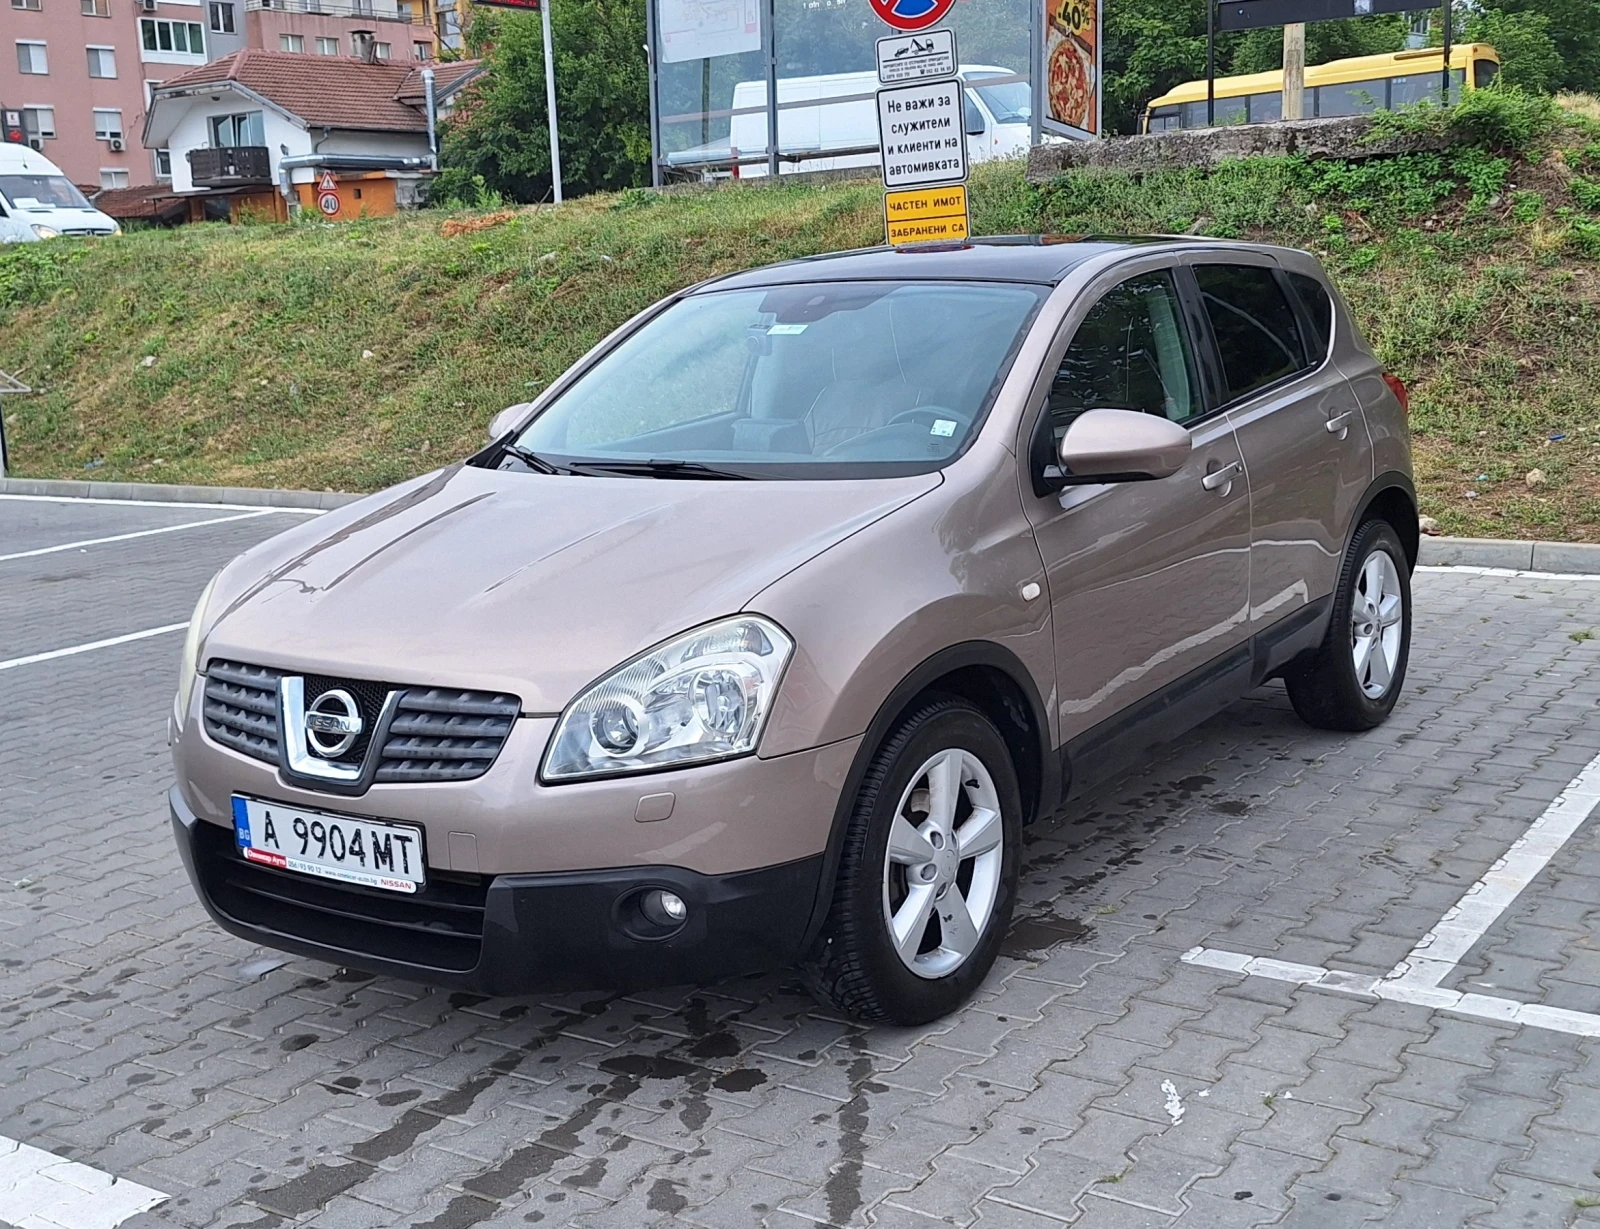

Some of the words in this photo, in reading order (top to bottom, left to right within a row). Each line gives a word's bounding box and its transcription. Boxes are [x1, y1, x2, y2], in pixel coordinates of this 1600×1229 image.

[887, 100, 902, 113] Не
[905, 97, 934, 111] важи
[938, 95, 951, 106] за
[891, 117, 951, 136] служители
[887, 145, 894, 155] и
[897, 139, 941, 154] клиенти
[945, 137, 958, 148] на
[889, 158, 960, 176] автомивката
[324, 198, 336, 210] 40
[889, 199, 928, 212] ЧАСТЕН
[933, 195, 961, 208] ИМОТ
[890, 224, 947, 238] ЗАБРАНЕНИ
[951, 223, 965, 233] СА
[307, 715, 351, 733] NISSAN
[238, 828, 250, 841] BG
[264, 811, 280, 849] A
[381, 878, 412, 890] NISSAN
